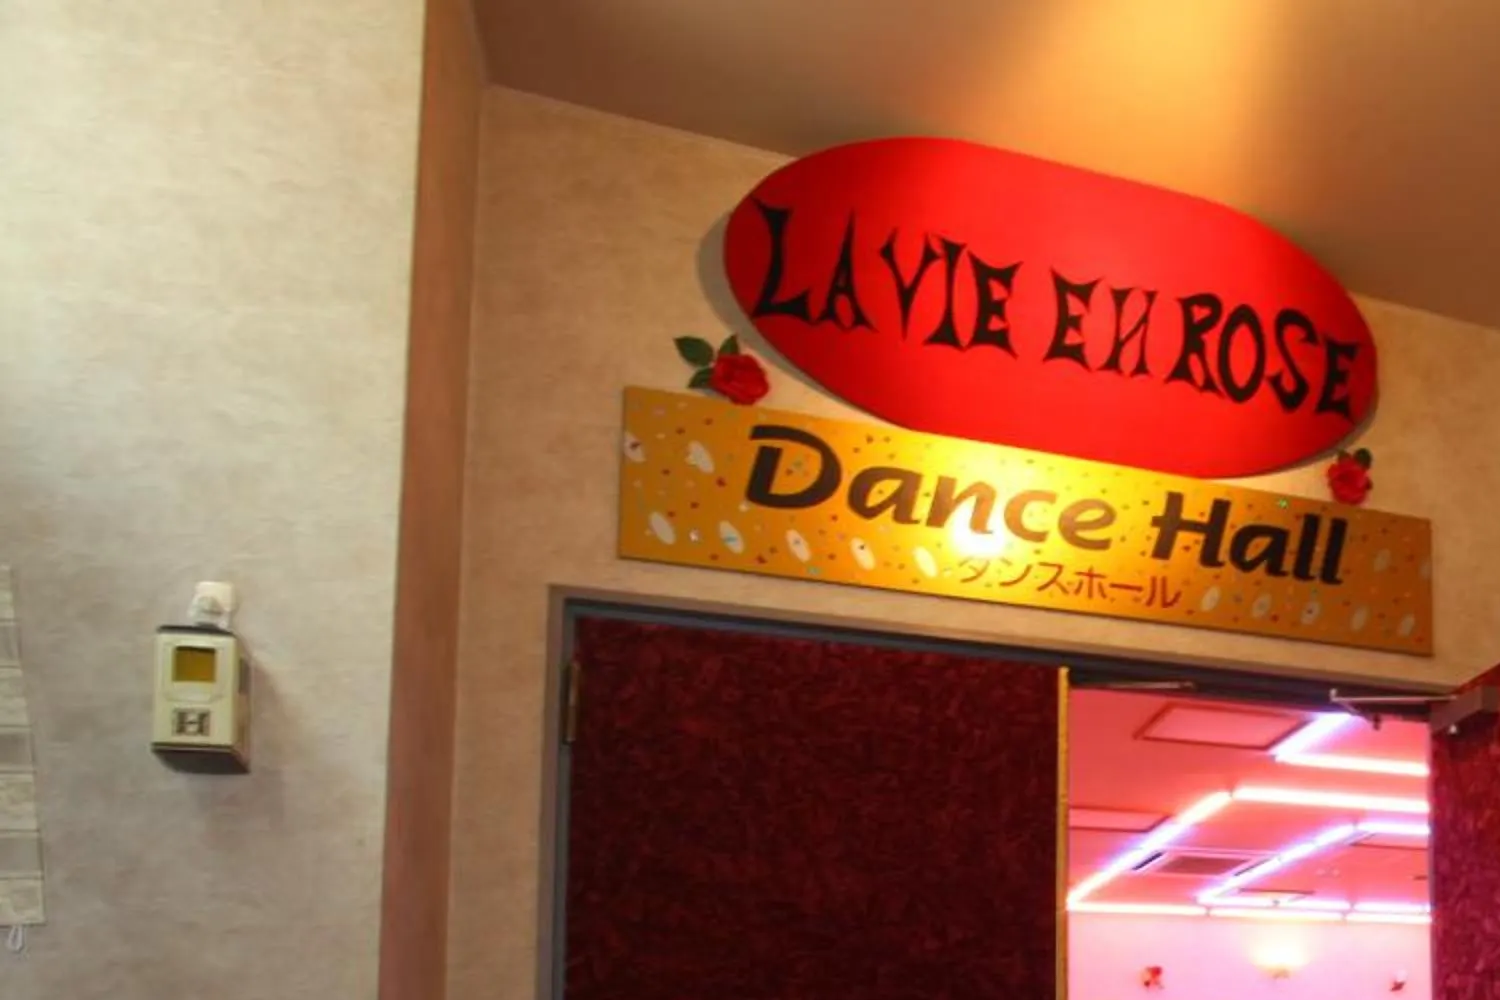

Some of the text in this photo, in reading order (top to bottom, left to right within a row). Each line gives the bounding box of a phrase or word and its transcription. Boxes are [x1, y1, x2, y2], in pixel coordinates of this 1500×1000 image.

[752, 200, 877, 333] LA
[881, 228, 1023, 360] VIE
[1165, 293, 1360, 424] ROSE
[744, 425, 1349, 585] Dance Hall
